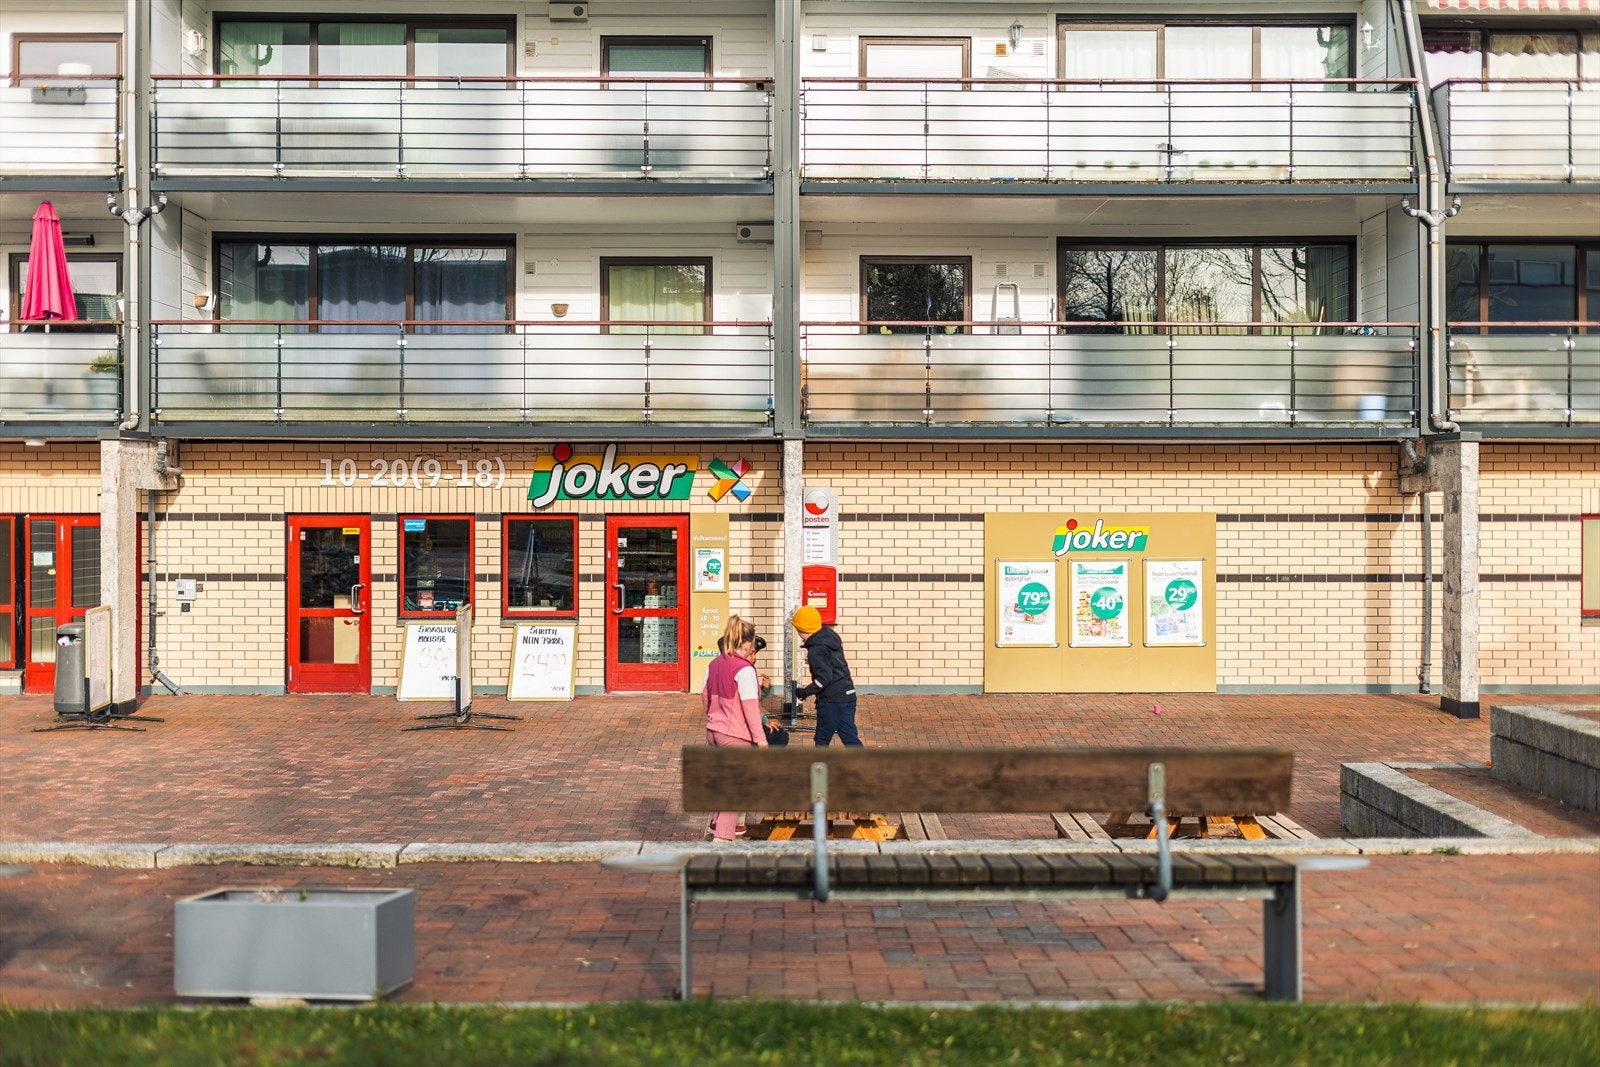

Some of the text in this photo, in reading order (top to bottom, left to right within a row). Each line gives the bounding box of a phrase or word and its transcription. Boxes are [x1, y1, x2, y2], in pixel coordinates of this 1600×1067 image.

[320, 457, 505, 490] 10-20(9-18)
[532, 443, 688, 508] joker
[1055, 519, 1143, 557] joker
[702, 606, 718, 614] Åpent
